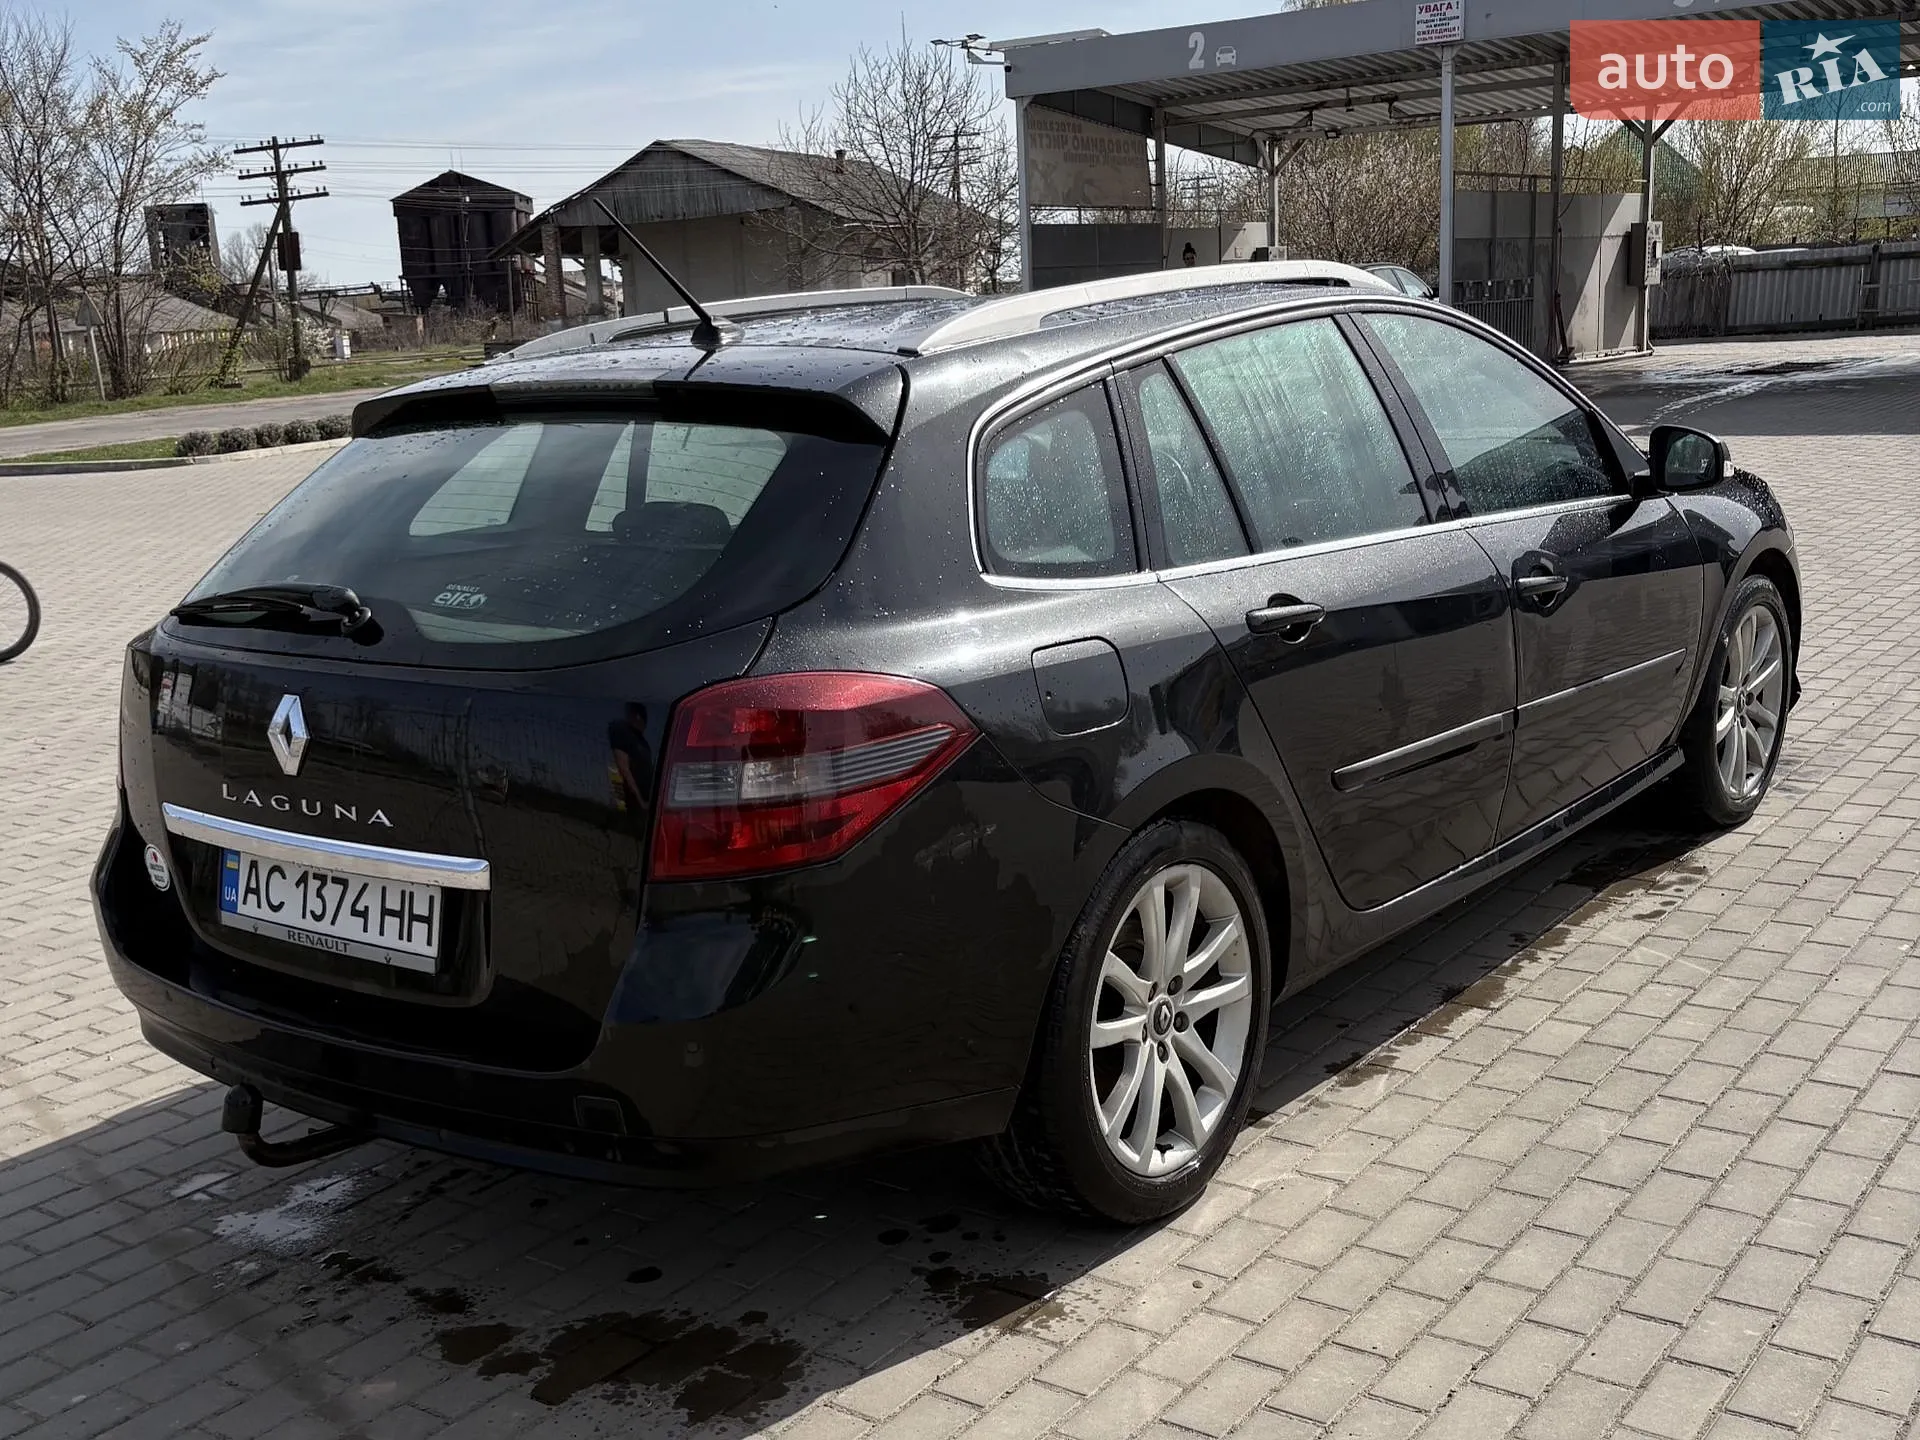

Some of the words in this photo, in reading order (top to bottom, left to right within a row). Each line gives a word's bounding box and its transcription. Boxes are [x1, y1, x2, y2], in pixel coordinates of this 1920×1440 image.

[1418, 2, 1453, 14] УВАГА
[1188, 31, 1205, 69] 2
[434, 592, 471, 605] elf
[222, 783, 394, 827] LAGUNA
[224, 890, 237, 902] UA
[287, 929, 350, 953] RENAULT
